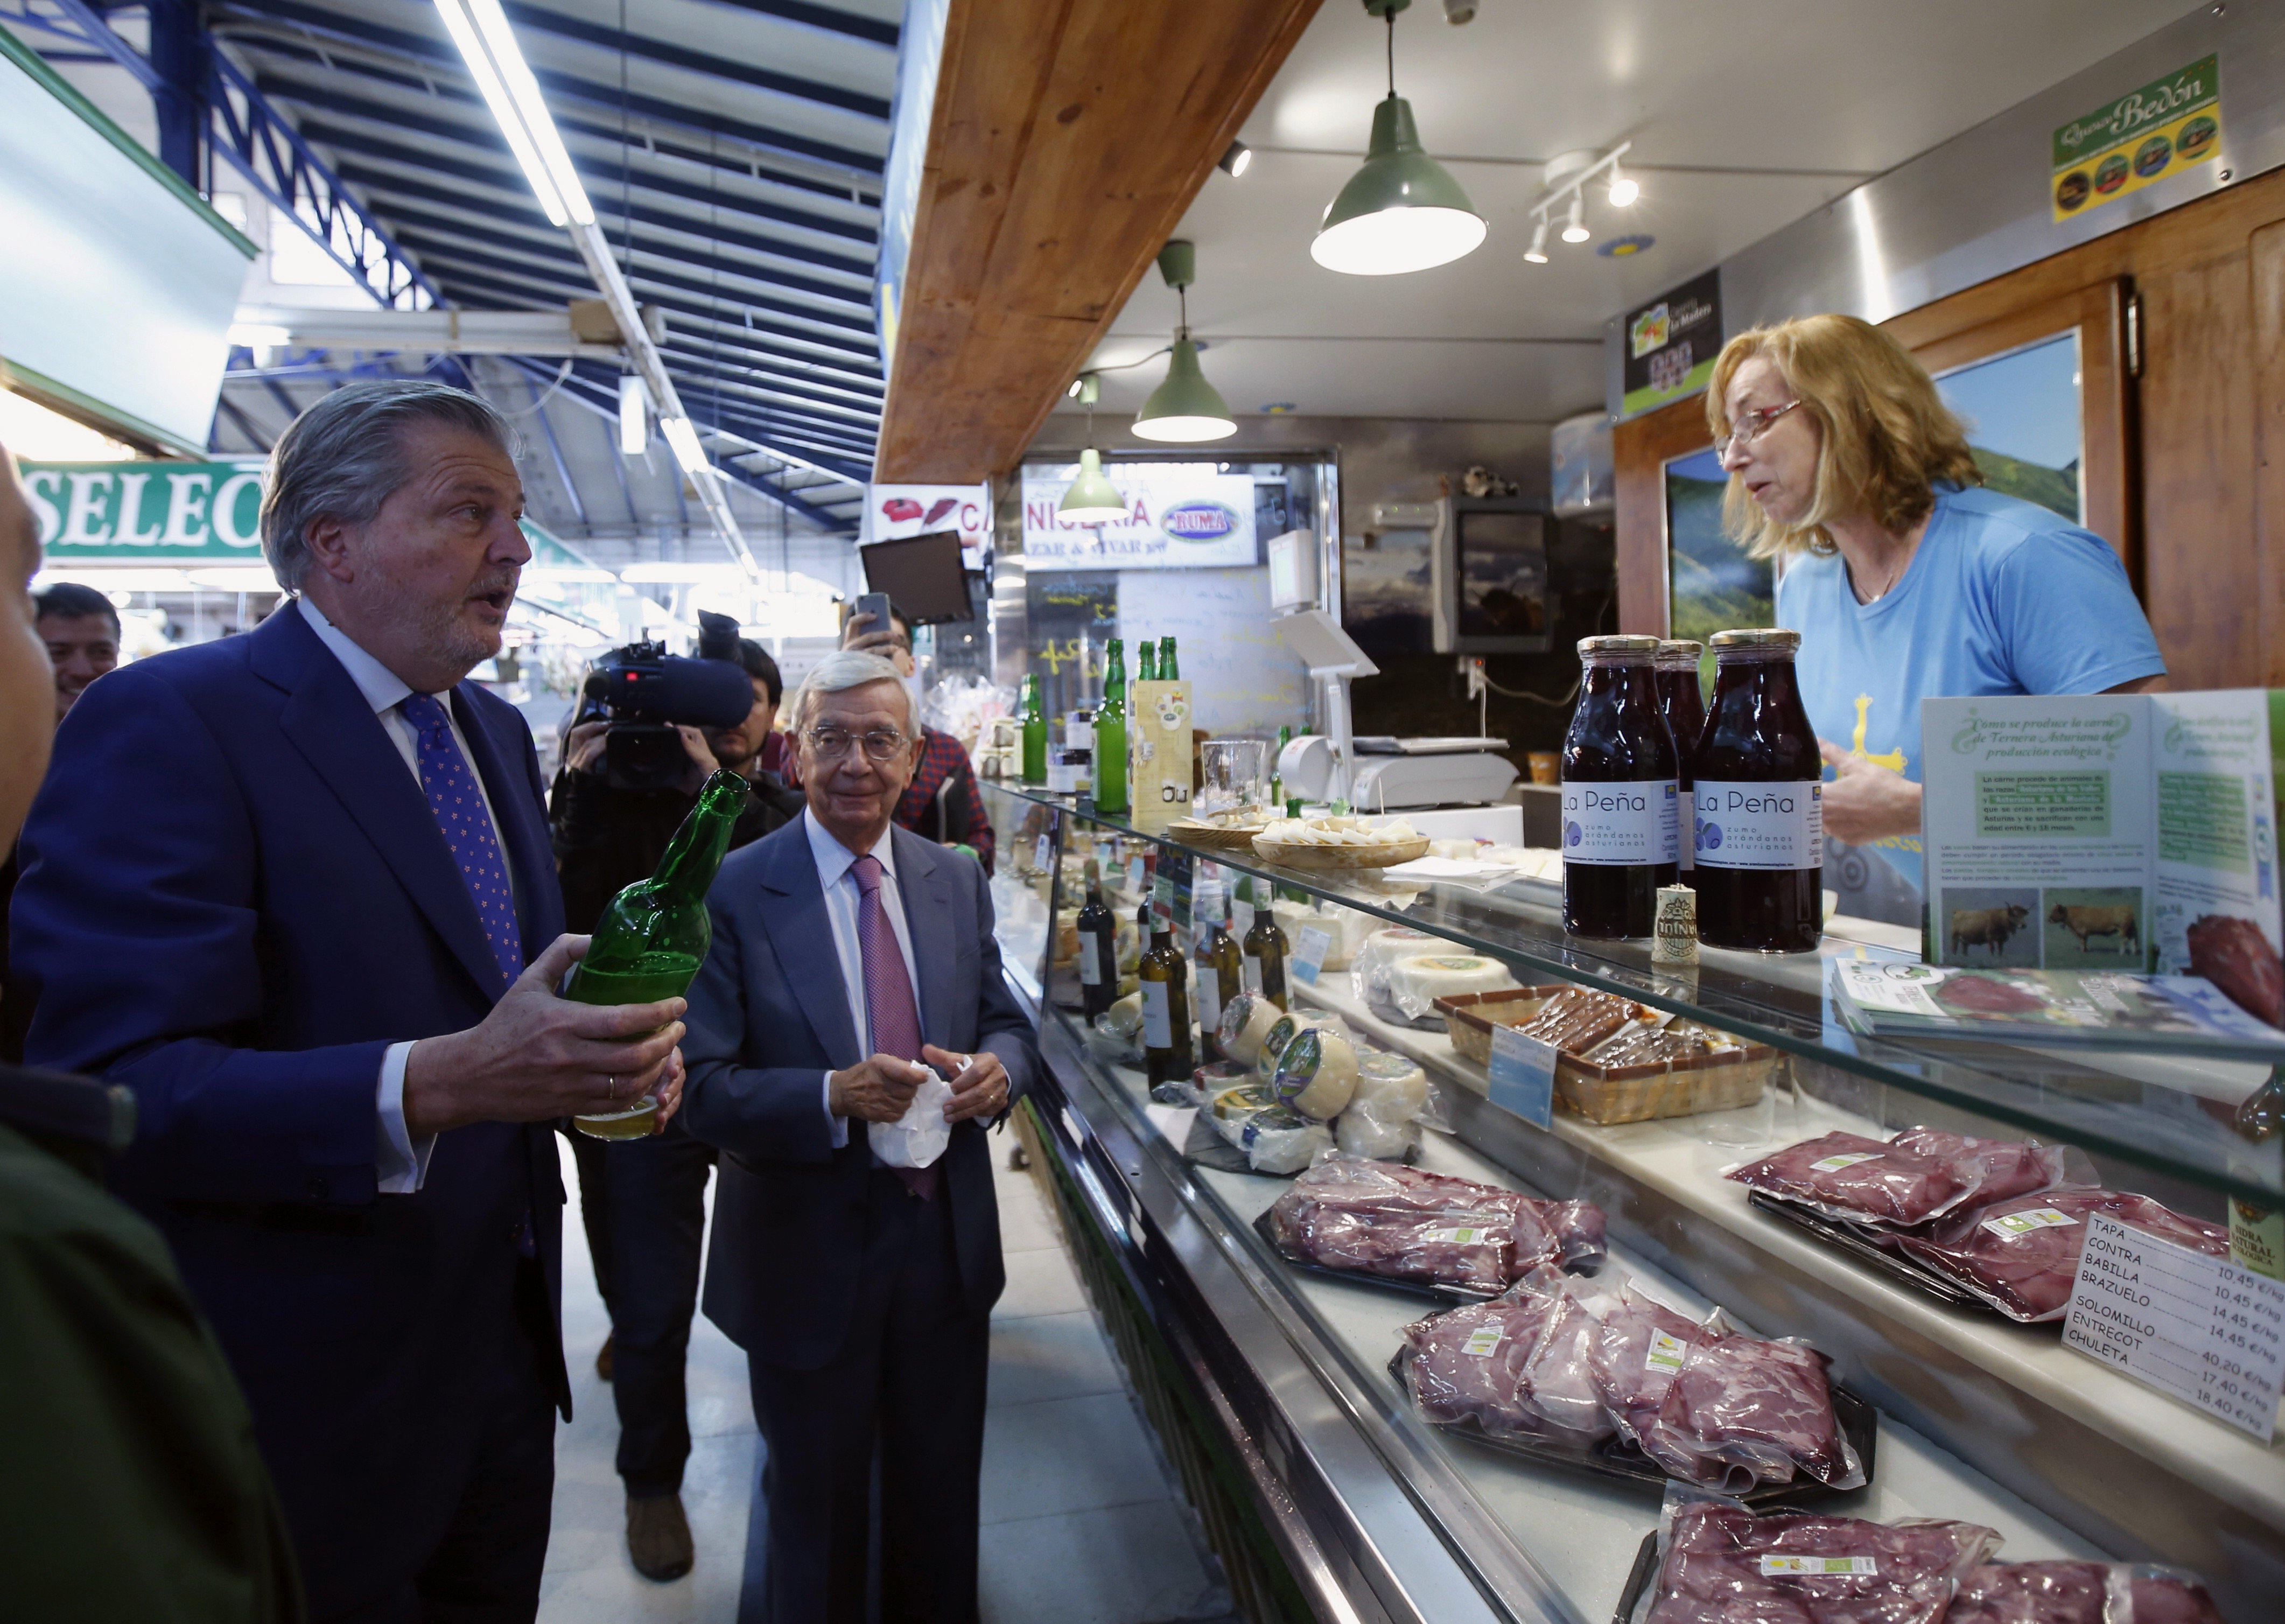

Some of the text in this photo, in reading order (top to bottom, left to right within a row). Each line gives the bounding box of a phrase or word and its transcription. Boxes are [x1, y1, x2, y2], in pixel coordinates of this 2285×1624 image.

[2109, 76, 2205, 136] Bedón
[1174, 510, 1229, 534] RUMA
[1972, 732, 1987, 743] de
[1989, 731, 2037, 743] Ternera
[2021, 717, 2069, 732] produce
[1563, 790, 1646, 812] La Peña
[1698, 789, 1794, 814] La Peña
[1585, 831, 1644, 839] arándanos
[2094, 1218, 2126, 1240] TAPA
[2235, 1224, 2263, 1244] SIDRA
[2088, 1237, 2141, 1266] CONTRA
[2231, 1231, 2276, 1259] NATURAL
[2085, 1252, 2139, 1284] BABILLA
[2081, 1270, 2150, 1307] BRAZUELO
[2076, 1295, 2155, 1337] SOLOMILLO
[2073, 1311, 2143, 1350] ENTRECOT
[2069, 1329, 2128, 1366] CHULETA
